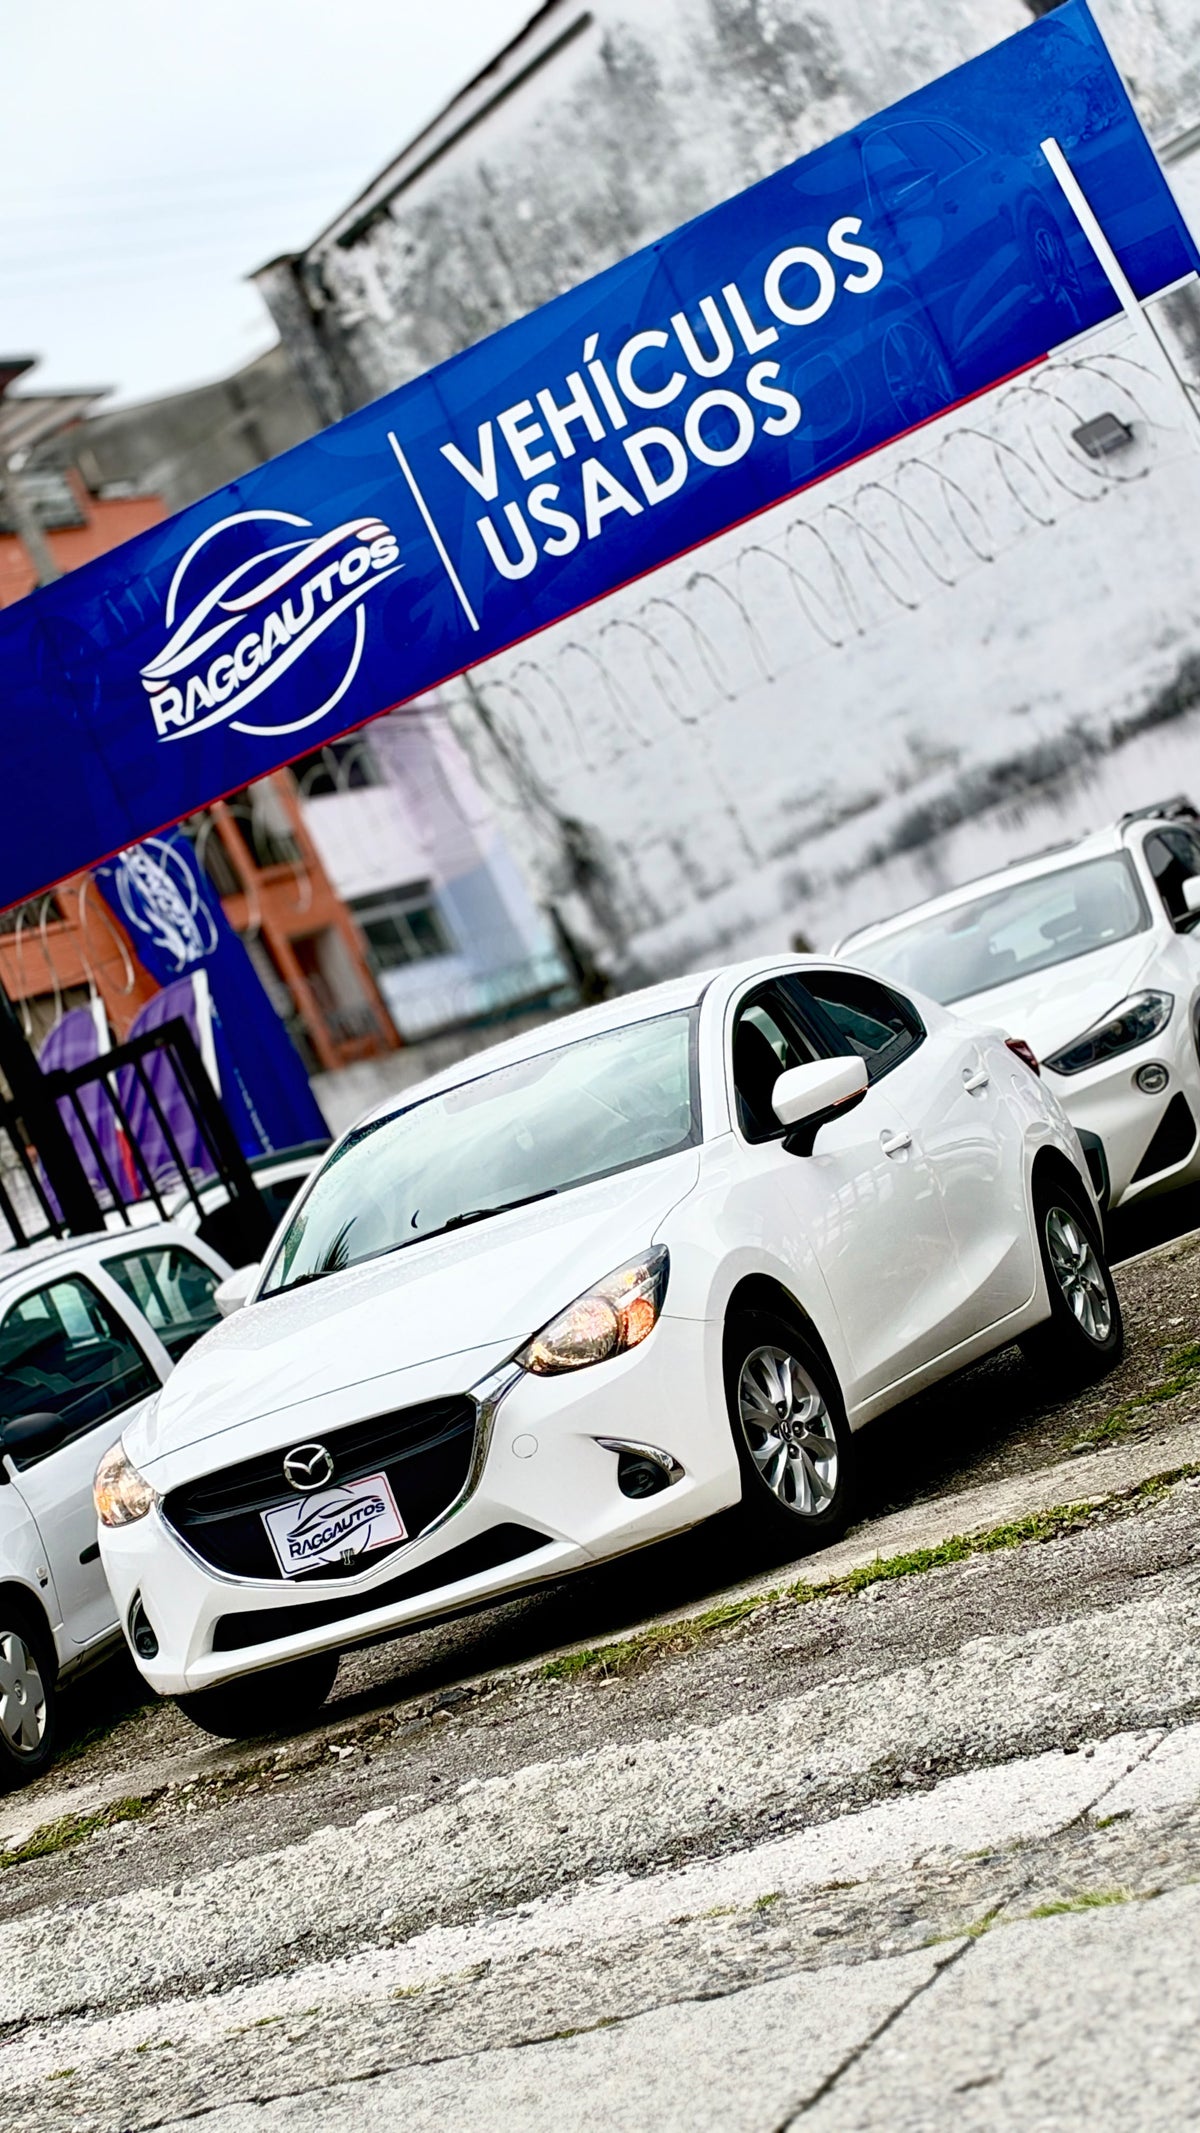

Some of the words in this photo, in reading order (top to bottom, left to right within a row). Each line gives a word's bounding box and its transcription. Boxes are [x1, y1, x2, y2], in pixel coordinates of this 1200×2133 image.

[439, 216, 884, 502] VEHÍCULOS
[476, 361, 802, 580] USADOS
[150, 534, 400, 735] RAGGAUTOS
[288, 1501, 386, 1558] RAGGAUTOS
